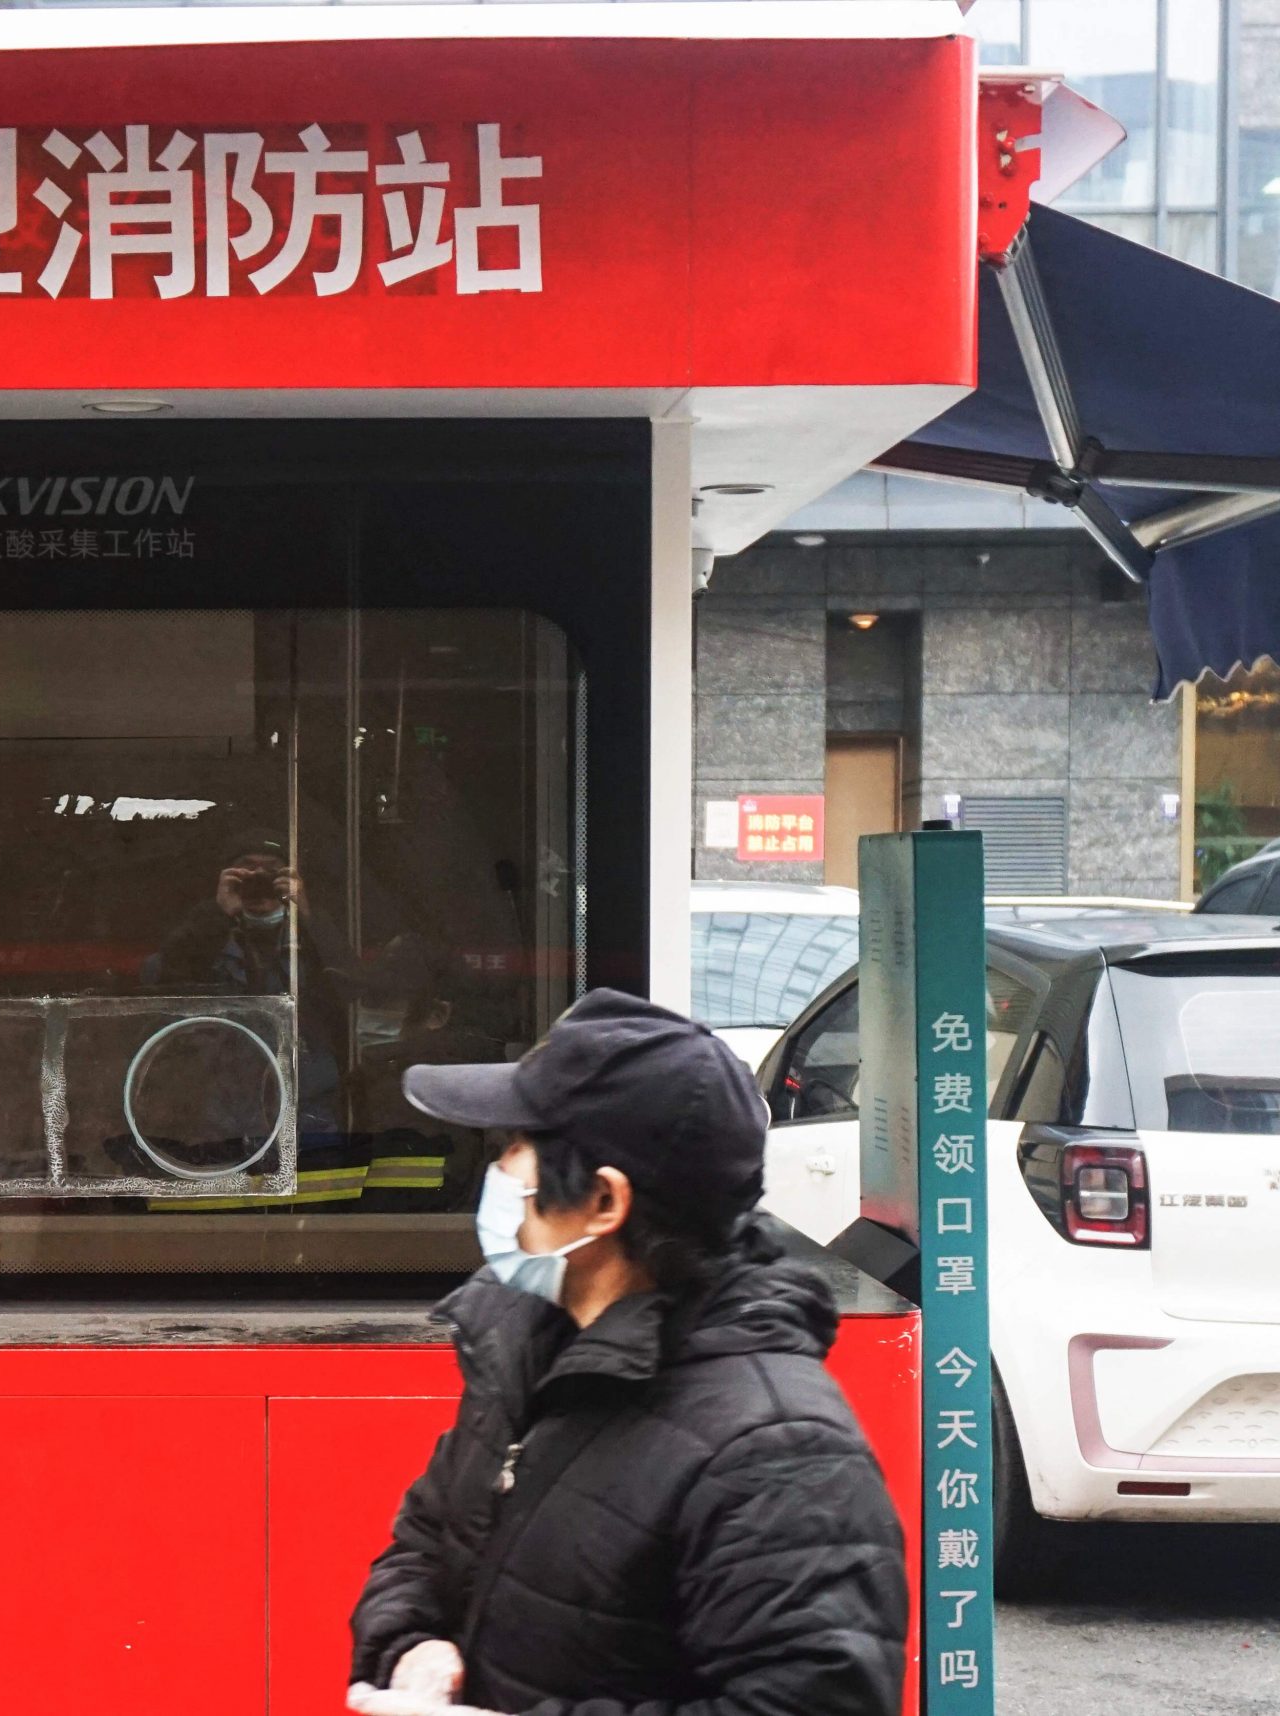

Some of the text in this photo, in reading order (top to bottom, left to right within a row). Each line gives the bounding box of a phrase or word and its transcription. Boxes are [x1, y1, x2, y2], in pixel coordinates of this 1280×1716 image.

[931, 1012, 980, 1689] 免费领口罩 今天你戴了吗
